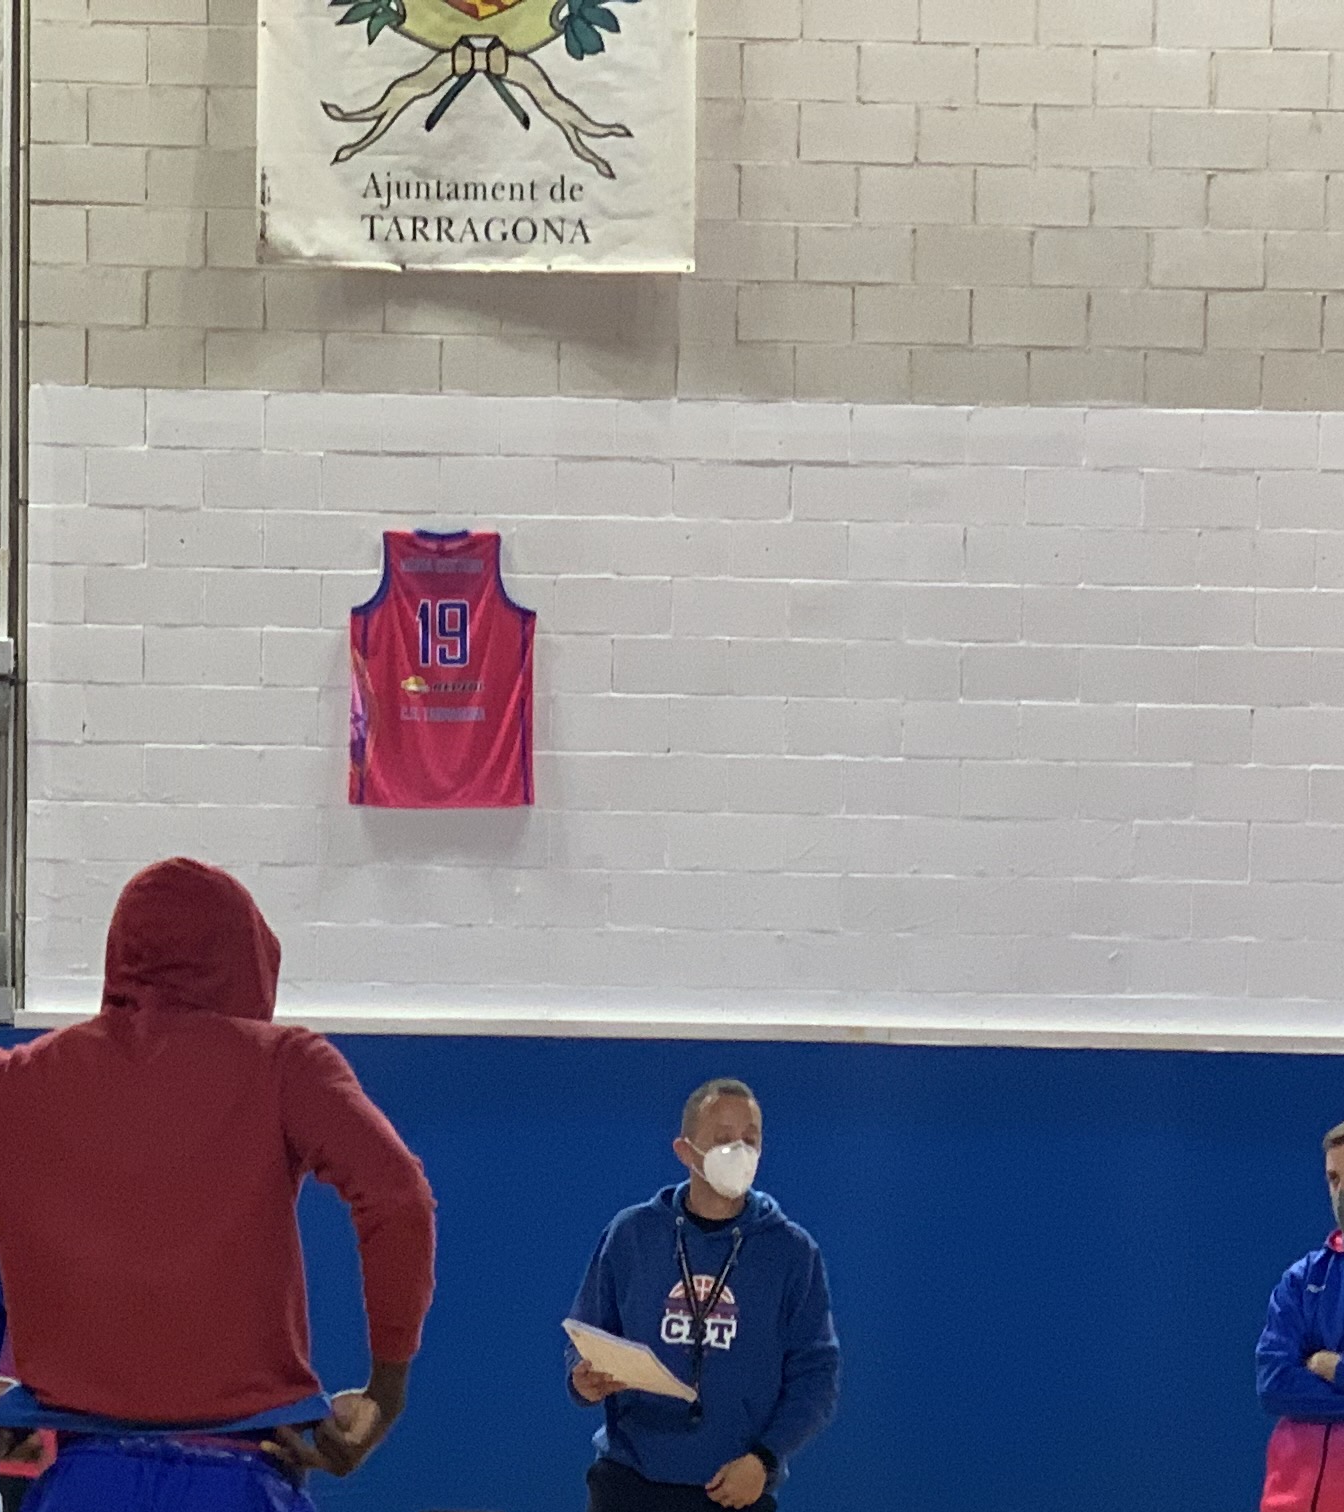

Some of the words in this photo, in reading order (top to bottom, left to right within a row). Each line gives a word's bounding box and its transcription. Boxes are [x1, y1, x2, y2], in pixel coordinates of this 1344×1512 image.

[361, 172, 538, 209] Ajuntament
[549, 174, 585, 202] de
[361, 214, 592, 245] TARRAGONA
[416, 599, 471, 668] 19
[661, 1313, 737, 1349] CT
